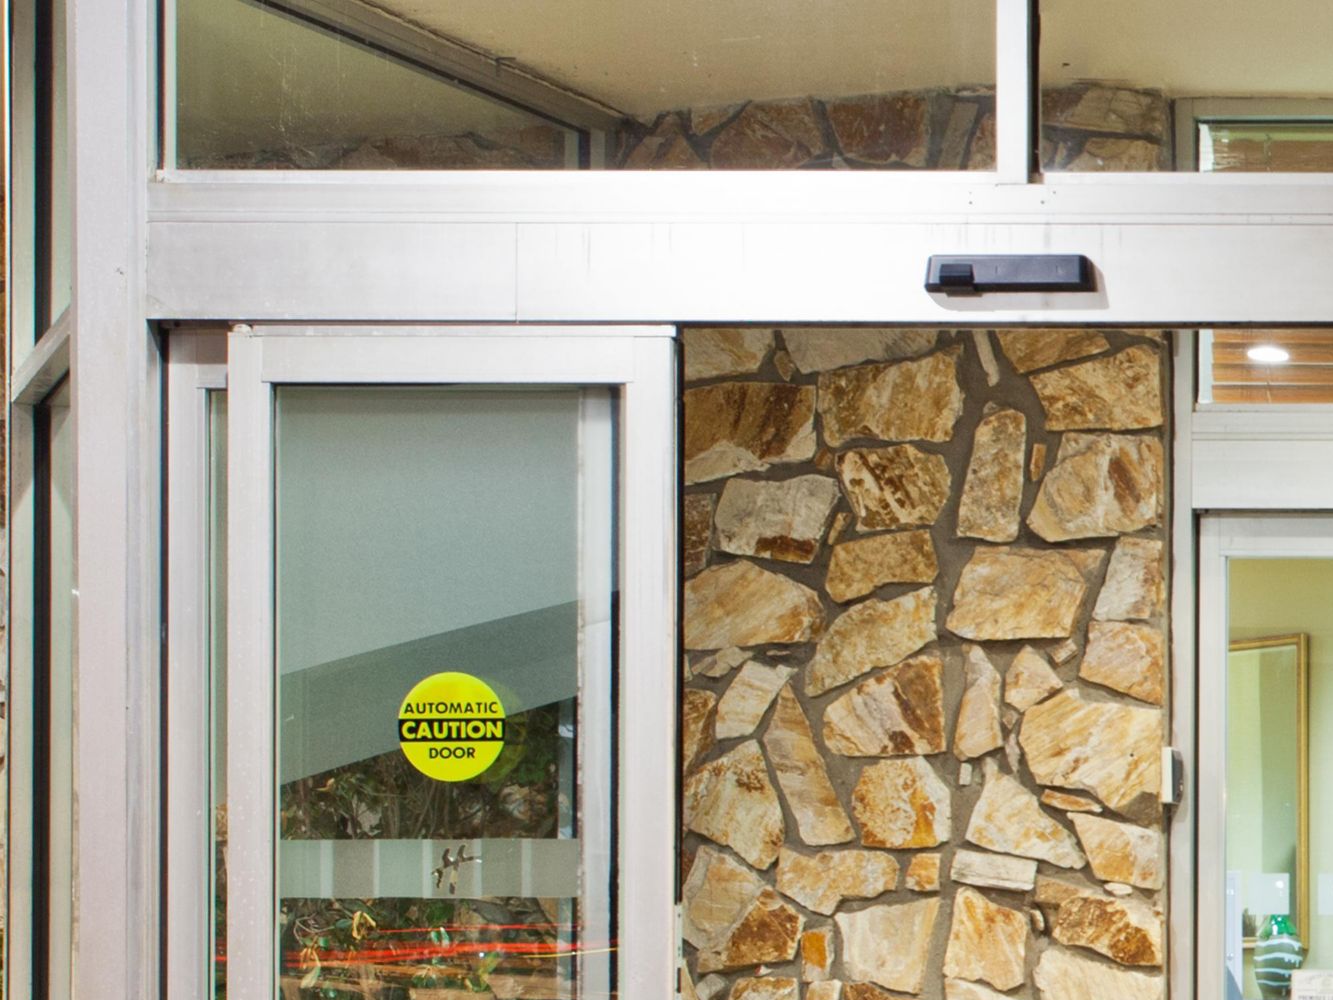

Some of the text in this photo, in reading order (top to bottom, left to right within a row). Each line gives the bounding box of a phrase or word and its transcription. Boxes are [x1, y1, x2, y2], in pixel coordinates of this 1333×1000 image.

[404, 702, 498, 714] AUTOMATIC
[401, 720, 503, 739] CAUTION
[429, 747, 475, 759] DOOR
